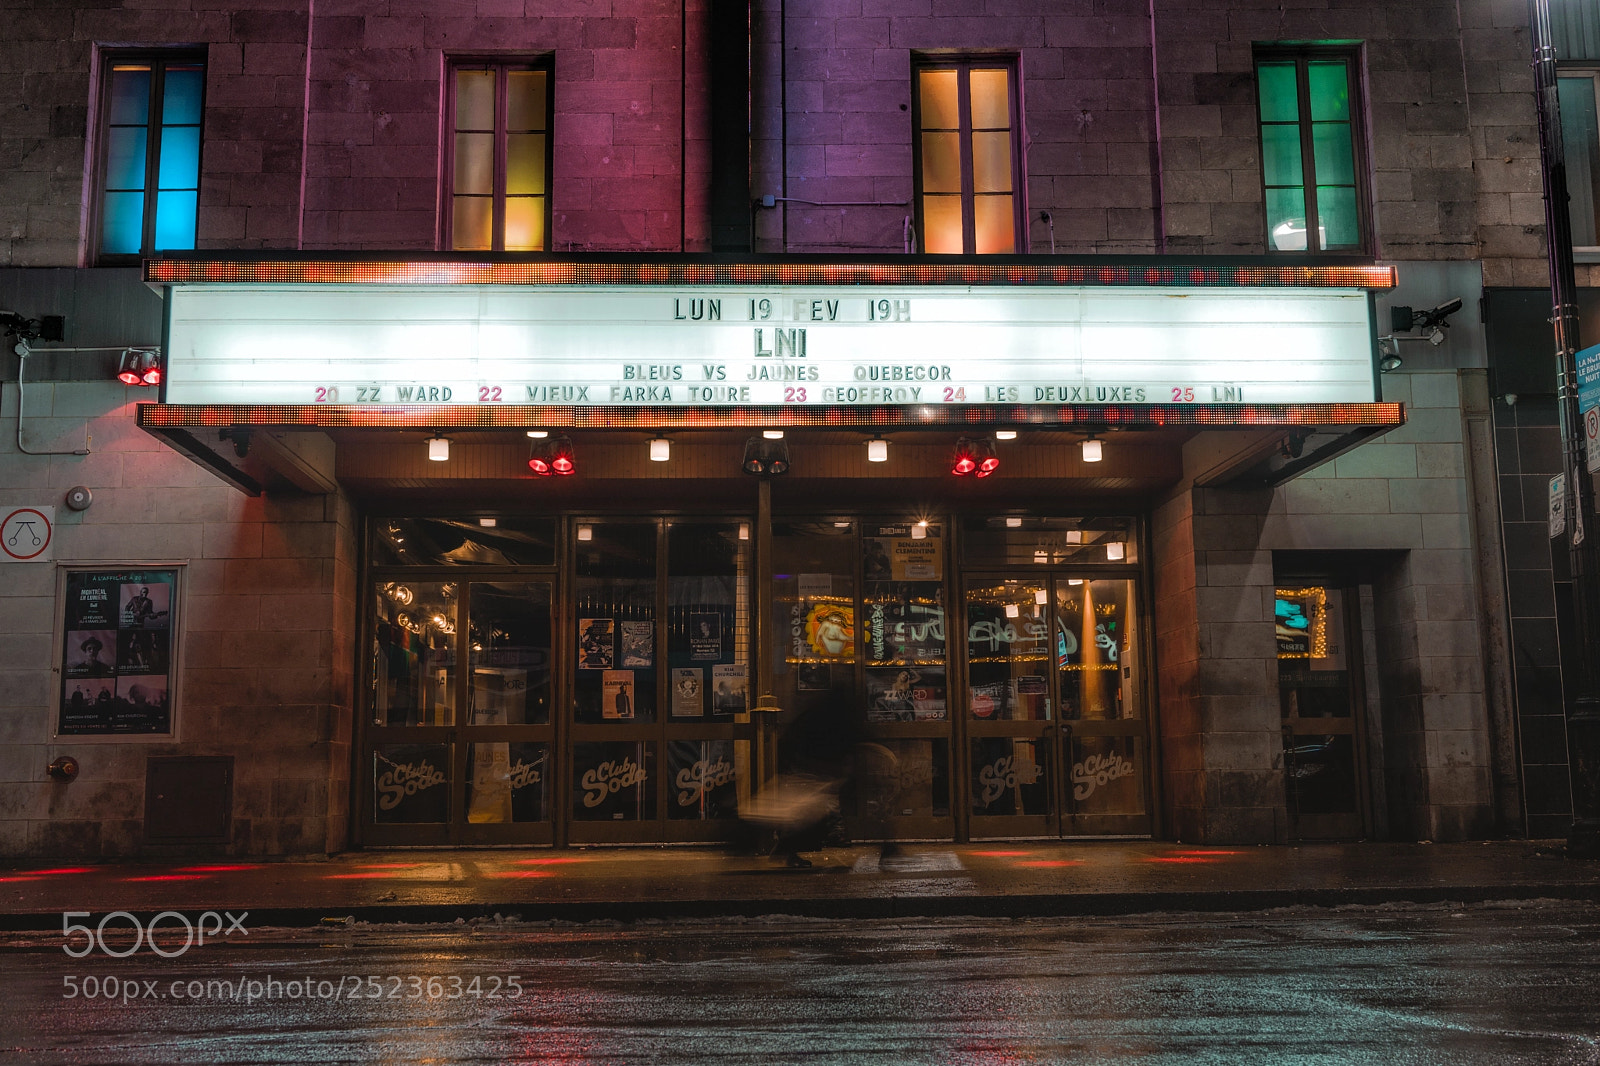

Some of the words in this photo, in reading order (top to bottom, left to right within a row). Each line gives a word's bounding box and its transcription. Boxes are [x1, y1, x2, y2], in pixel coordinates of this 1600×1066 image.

[673, 298, 721, 320] LUN
[748, 298, 773, 320] 19
[793, 298, 839, 320] FEV
[868, 298, 911, 321] 19H
[754, 327, 806, 358] LNI
[623, 365, 683, 380] BLEUS
[703, 365, 727, 380] VS
[747, 365, 819, 380] JAUNES
[853, 365, 952, 381] QUEBECOR
[315, 386, 339, 402] 20
[356, 386, 381, 402] ZZ
[396, 386, 453, 402] WARD
[479, 386, 502, 402] 22
[526, 386, 589, 402] VIEUX
[610, 386, 673, 402] FARKA
[688, 386, 750, 402] TOURE
[784, 387, 807, 402] 23
[822, 387, 922, 402] GEOFFROY
[943, 387, 966, 402] 24
[985, 386, 1019, 402] LES
[1035, 386, 1146, 402] DEUXLUXES
[1171, 386, 1195, 402] 25
[1212, 386, 1243, 402] LNI
[394, 758, 432, 783] Club
[596, 756, 630, 782] Club
[691, 755, 725, 780] Club
[1084, 750, 1116, 776] Club
[377, 764, 448, 812] Soda
[581, 762, 648, 808] Soda
[1070, 755, 1134, 801] Soda
